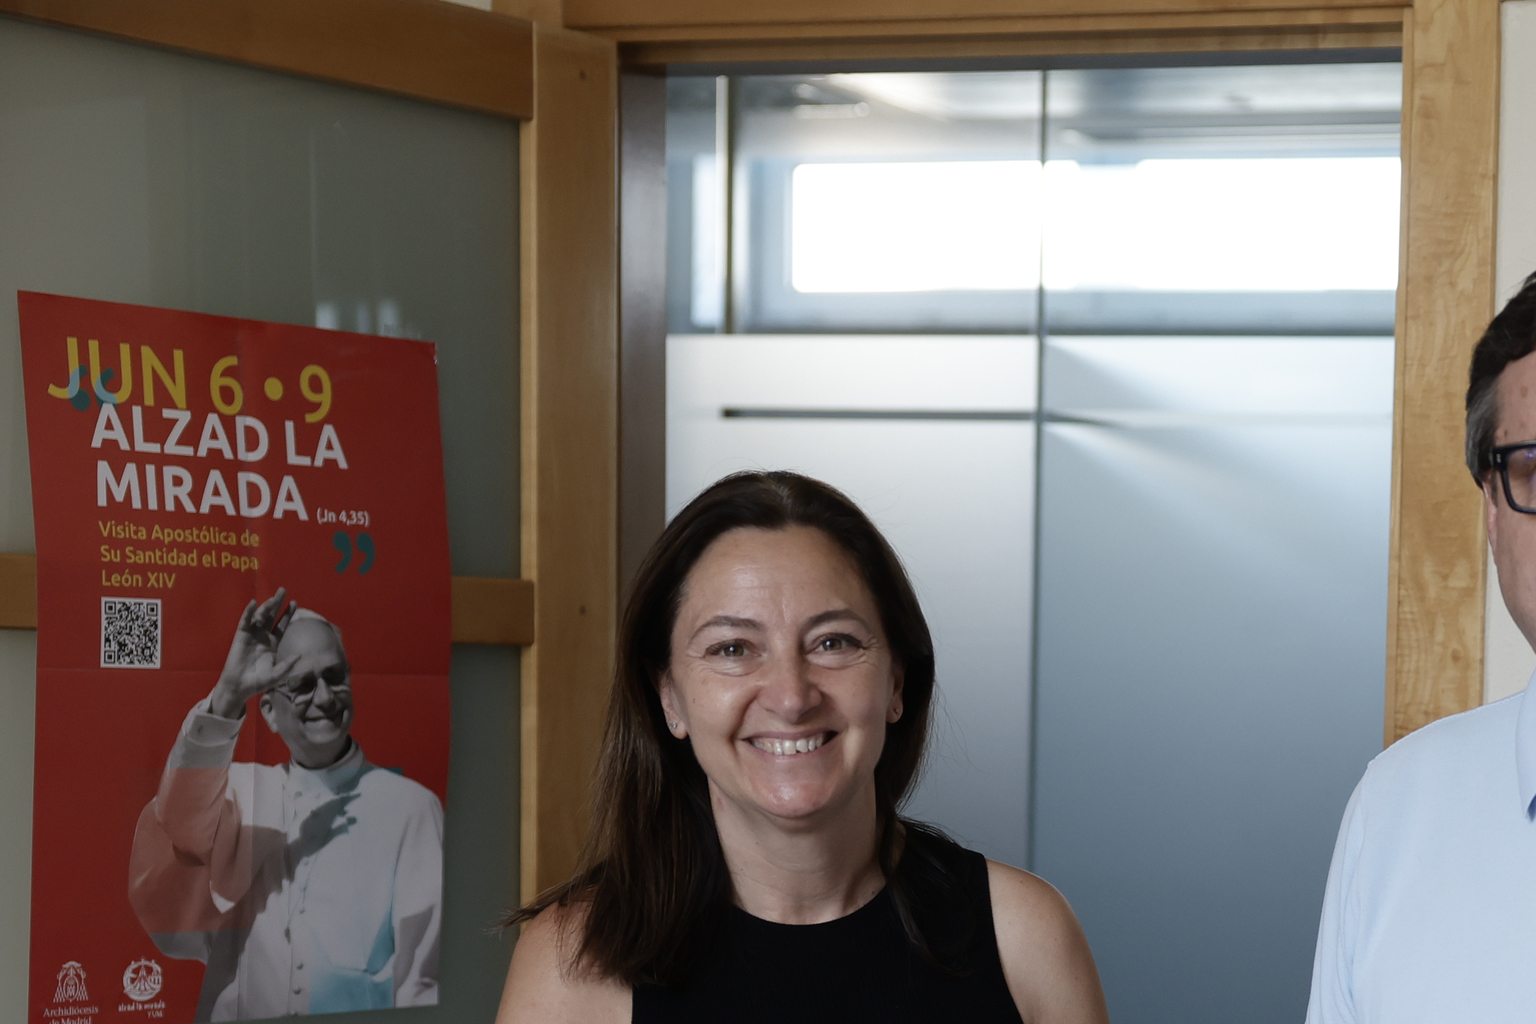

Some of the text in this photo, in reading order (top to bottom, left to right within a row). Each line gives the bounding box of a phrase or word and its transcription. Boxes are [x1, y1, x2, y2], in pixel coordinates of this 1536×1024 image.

[47, 336, 187, 409] JUN
[90, 402, 349, 470] ALZAD LA
[96, 459, 371, 528] MIRADA (Jn 4,35)
[98, 520, 261, 548] Visita Apostólica de
[100, 544, 260, 573] Su Santidad el Papa
[101, 569, 177, 589] León XIV
[43, 1004, 99, 1018] Archidiócesis
